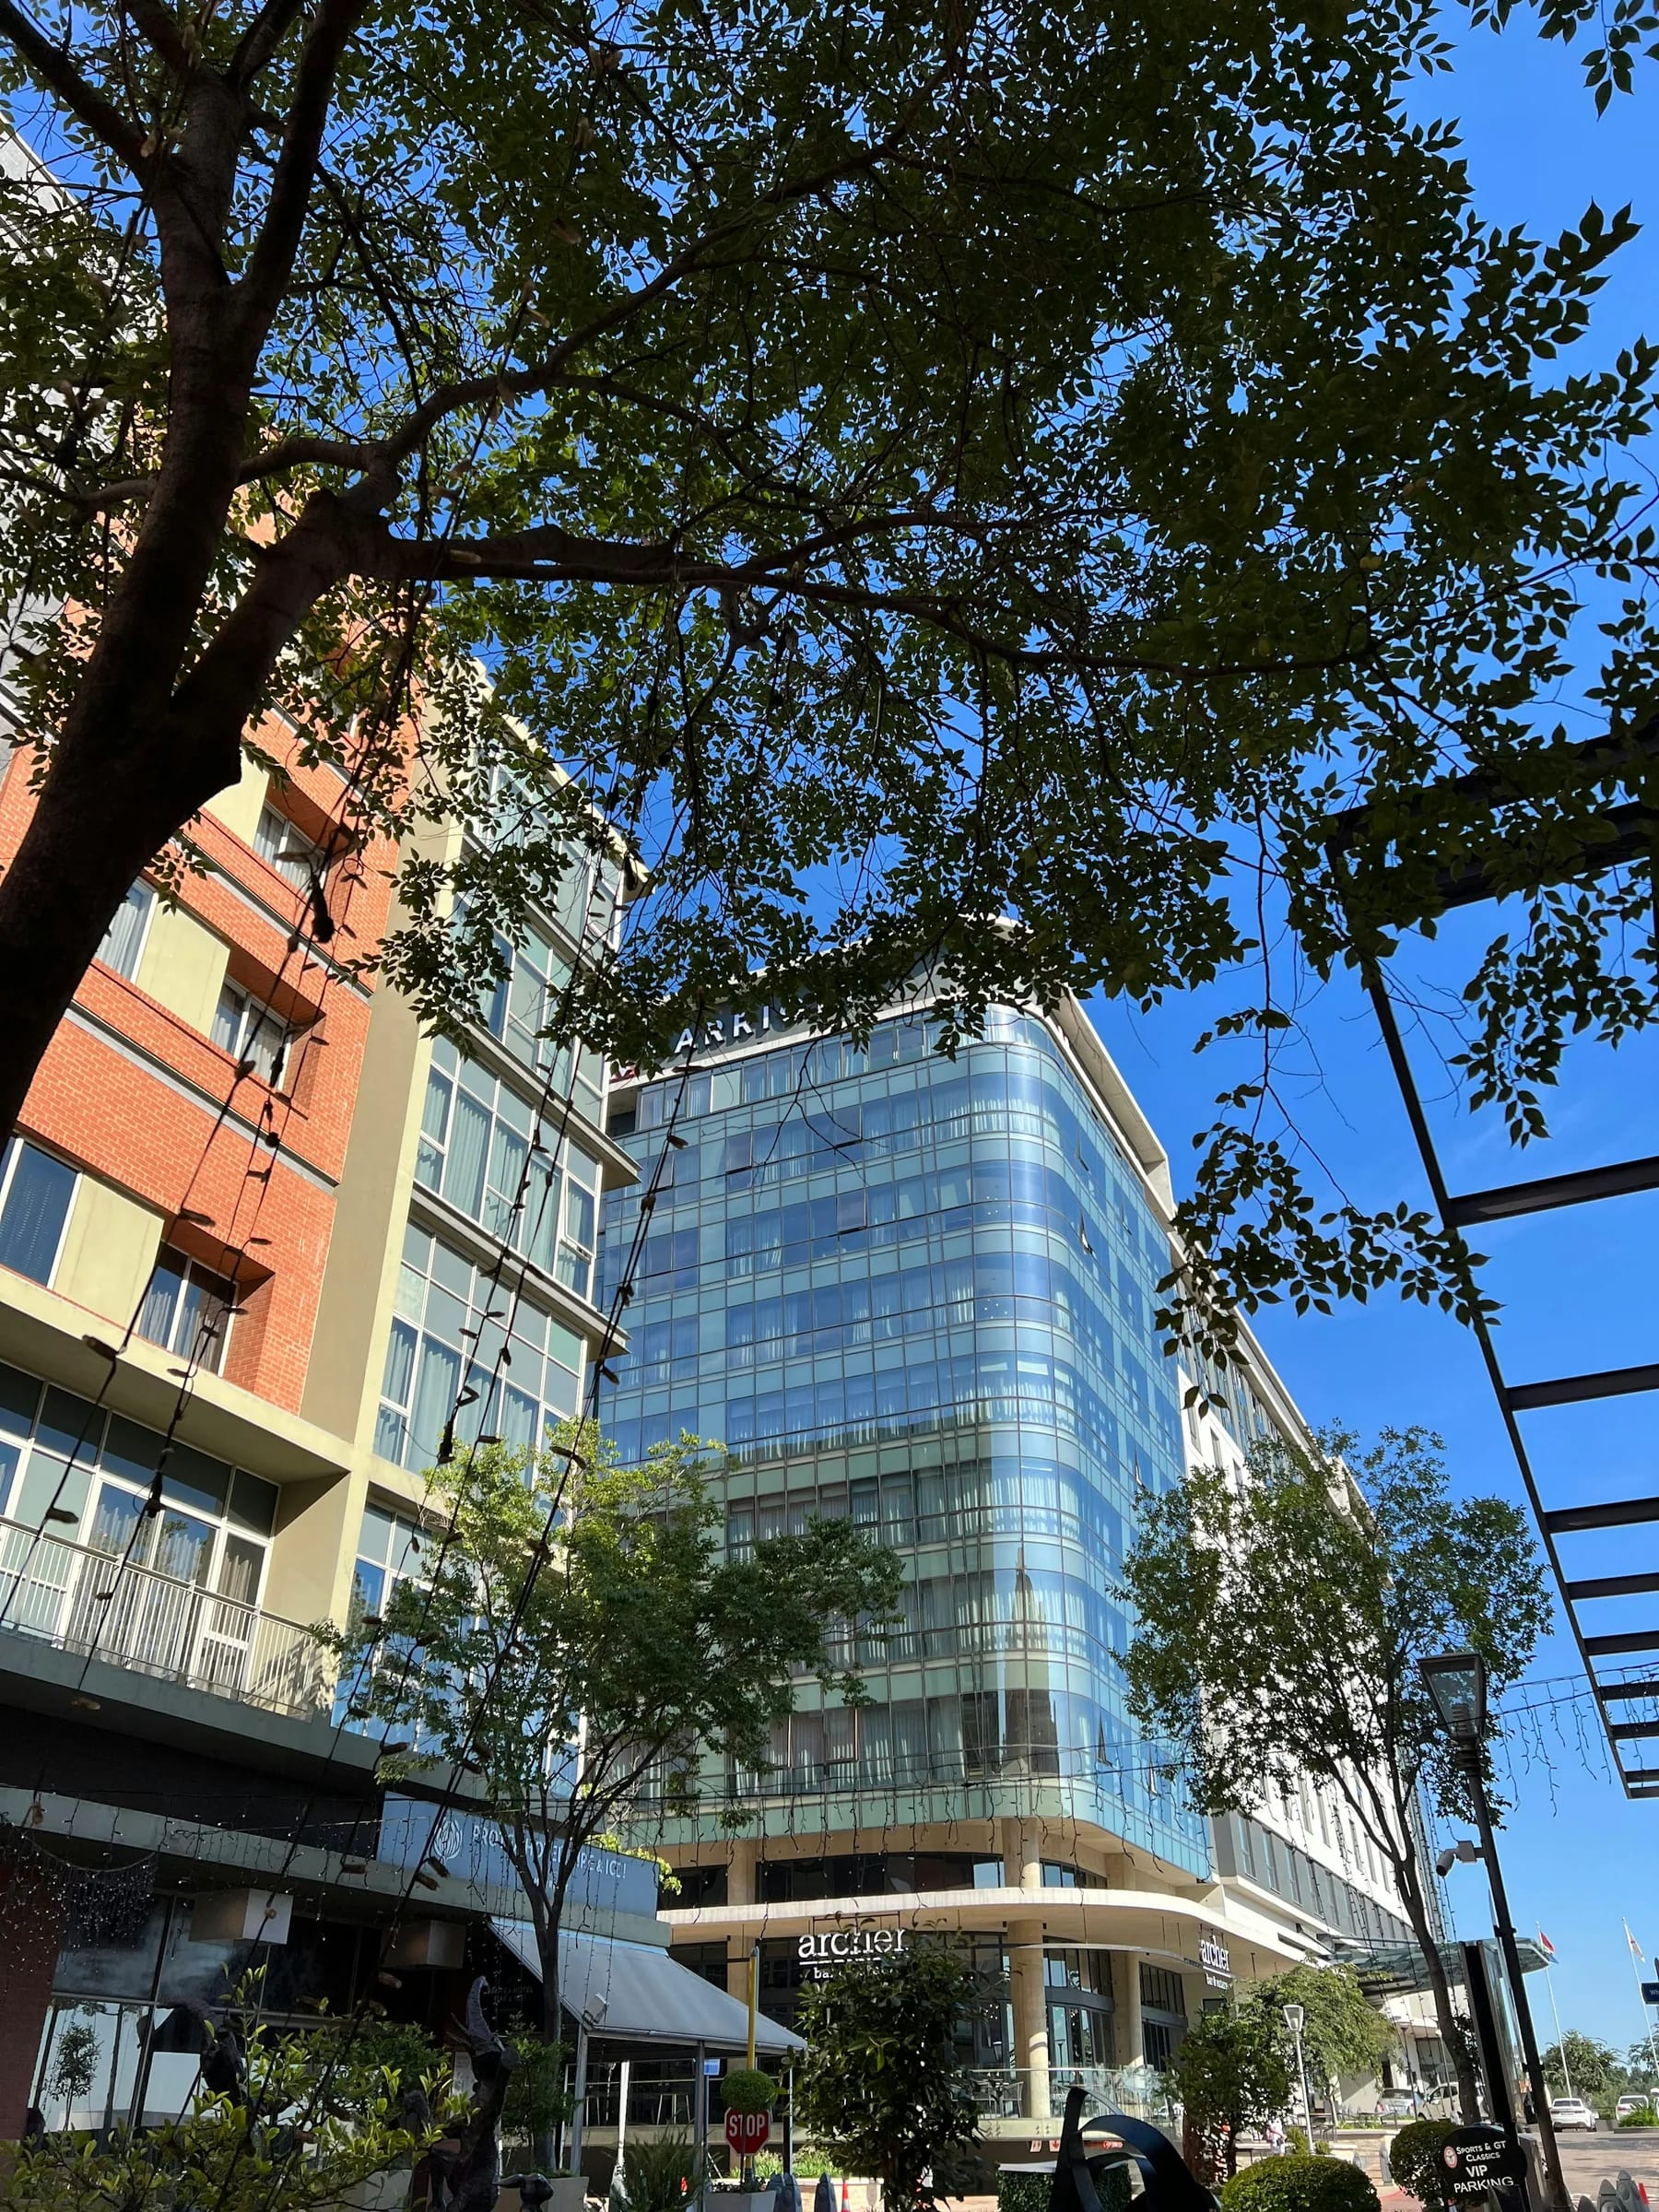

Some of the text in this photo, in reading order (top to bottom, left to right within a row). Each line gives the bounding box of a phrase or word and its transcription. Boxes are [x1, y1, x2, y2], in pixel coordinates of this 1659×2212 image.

[473, 1824, 517, 1853] PROA
[525, 1838, 562, 1863] HOEL
[797, 1926, 905, 1958] archer
[1200, 1935, 1230, 1971] archer
[729, 2114, 766, 2137] STOP
[1456, 2140, 1507, 2155] SPORTS & GT
[1465, 2151, 1500, 2162] CLASSICS
[1465, 2164, 1488, 2178] VIP
[1453, 2176, 1514, 2194] PARKING
